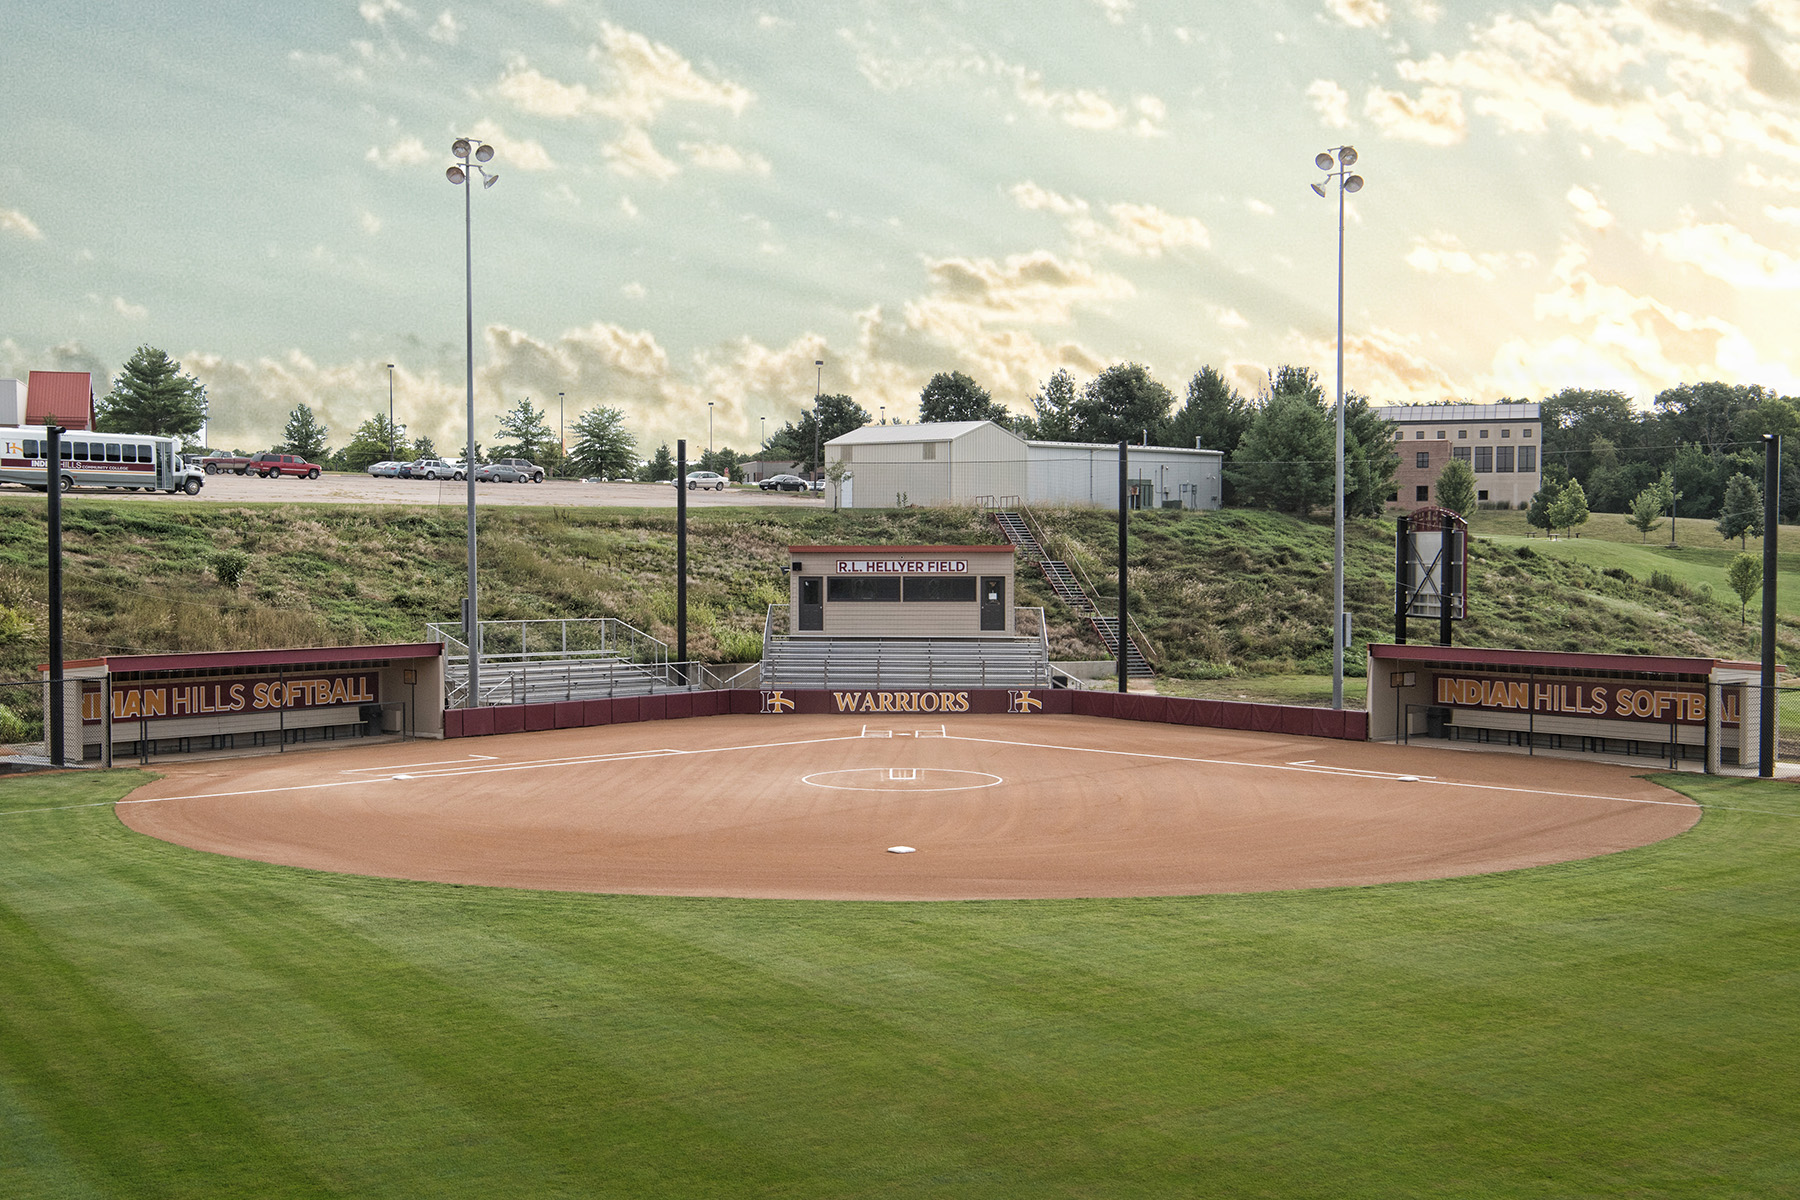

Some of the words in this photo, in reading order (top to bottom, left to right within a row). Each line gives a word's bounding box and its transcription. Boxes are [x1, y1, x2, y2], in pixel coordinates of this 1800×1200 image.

[60, 461, 82, 469] HILLS
[838, 561, 863, 572] R.L.
[866, 561, 924, 572] HELLYER
[928, 561, 966, 572] FIELD
[172, 684, 246, 714] HILLS
[253, 677, 373, 706] SOFTBALL
[834, 691, 970, 713] WARRIORS
[1437, 678, 1529, 709] INDIAN
[1533, 683, 1608, 714] HILLS
[1615, 688, 1740, 723] SOFTBL
